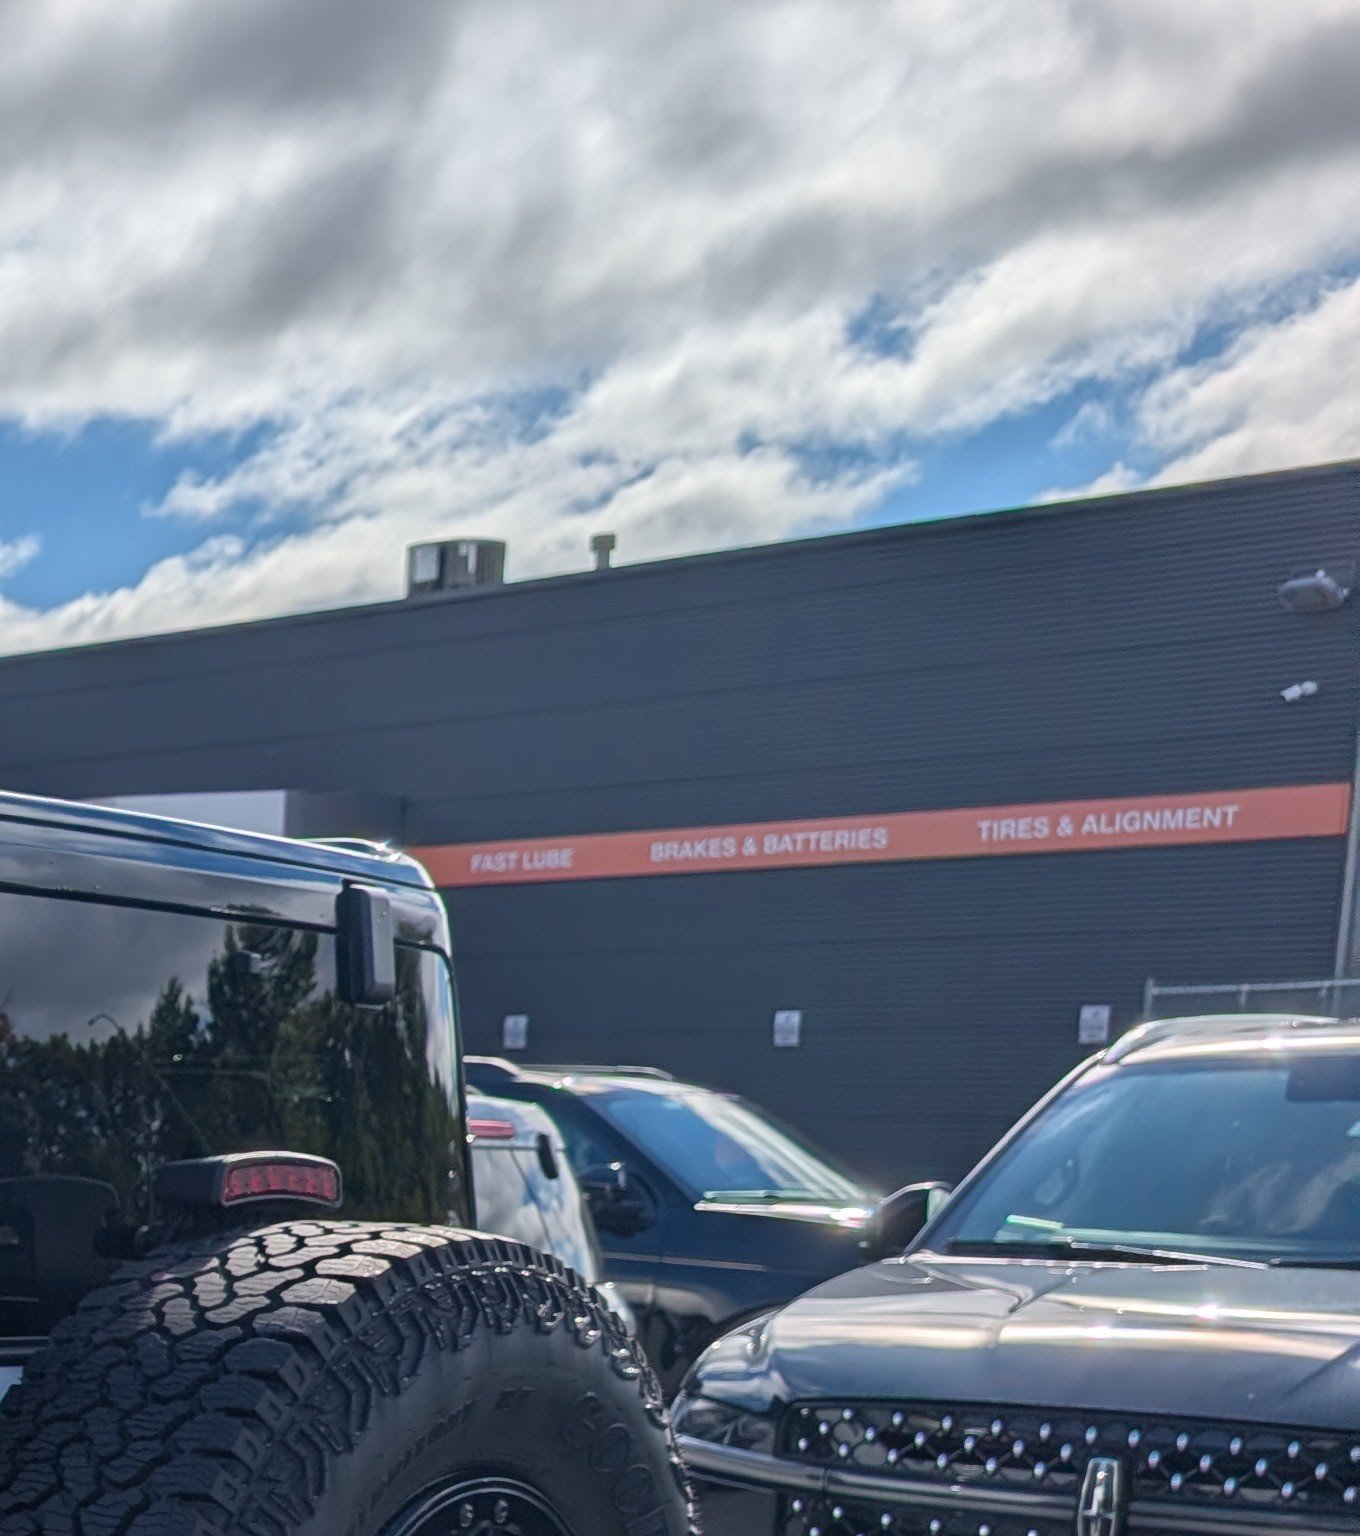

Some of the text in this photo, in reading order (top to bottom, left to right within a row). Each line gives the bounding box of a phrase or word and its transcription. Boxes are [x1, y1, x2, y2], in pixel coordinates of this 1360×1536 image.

[978, 804, 1240, 842] TIRES & ALIGNMENT
[471, 847, 574, 873] FAST LUBE
[650, 827, 888, 862] BRAKES & BATTERIES
